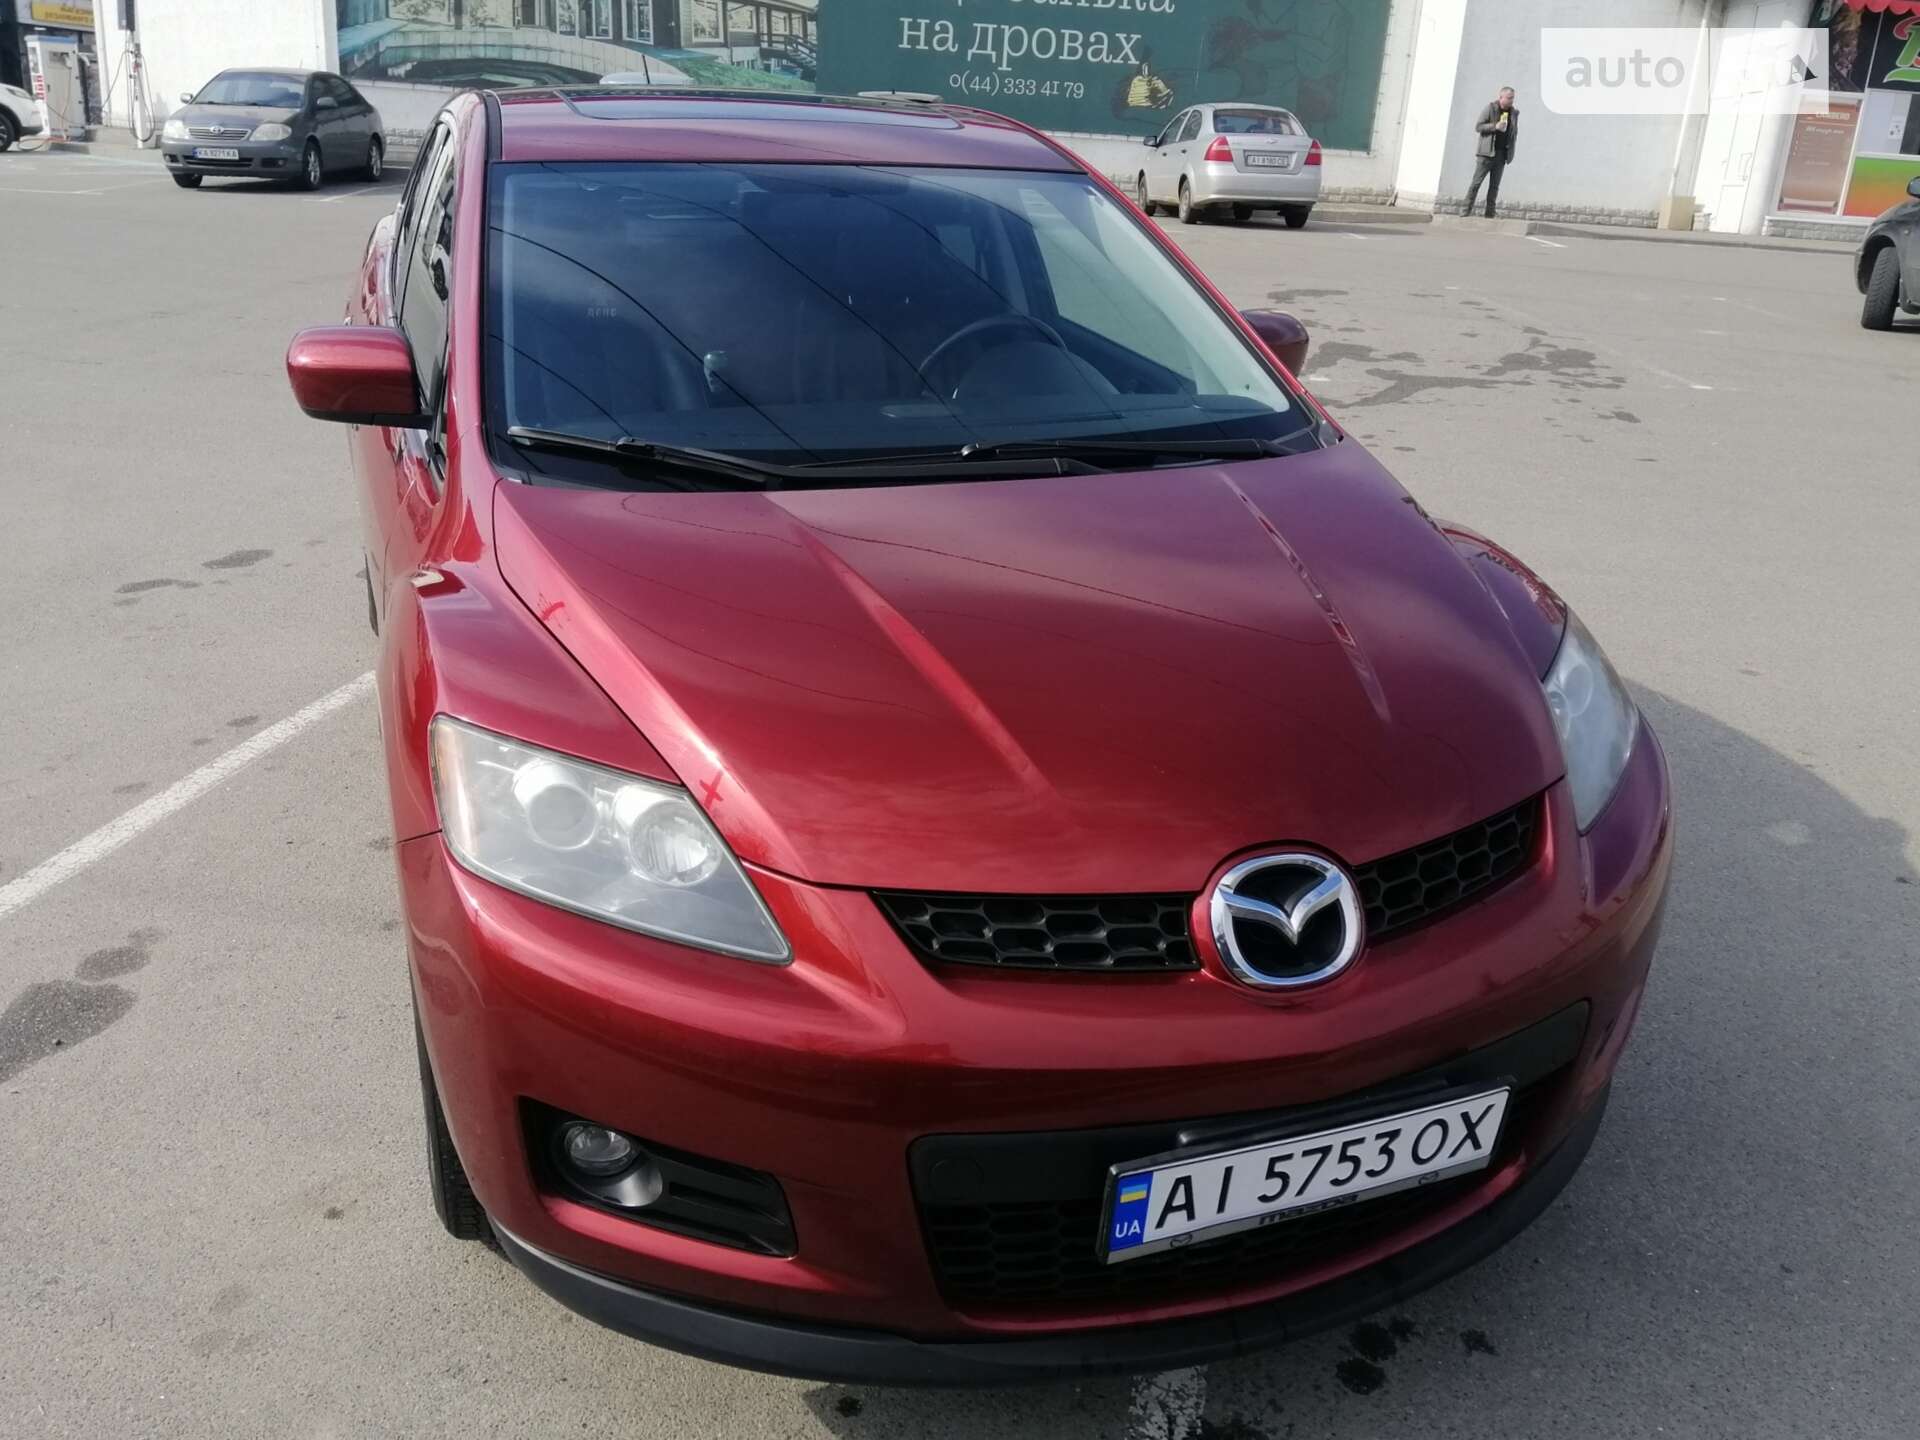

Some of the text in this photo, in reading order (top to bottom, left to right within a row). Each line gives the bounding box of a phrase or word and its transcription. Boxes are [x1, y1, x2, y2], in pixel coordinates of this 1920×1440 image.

[898, 17, 1142, 71] на дровах
[949, 70, 1085, 99] 0(44) 333 41 79
[1155, 1103, 1497, 1230] AI 5753 OX
[1115, 1221, 1142, 1239] UA
